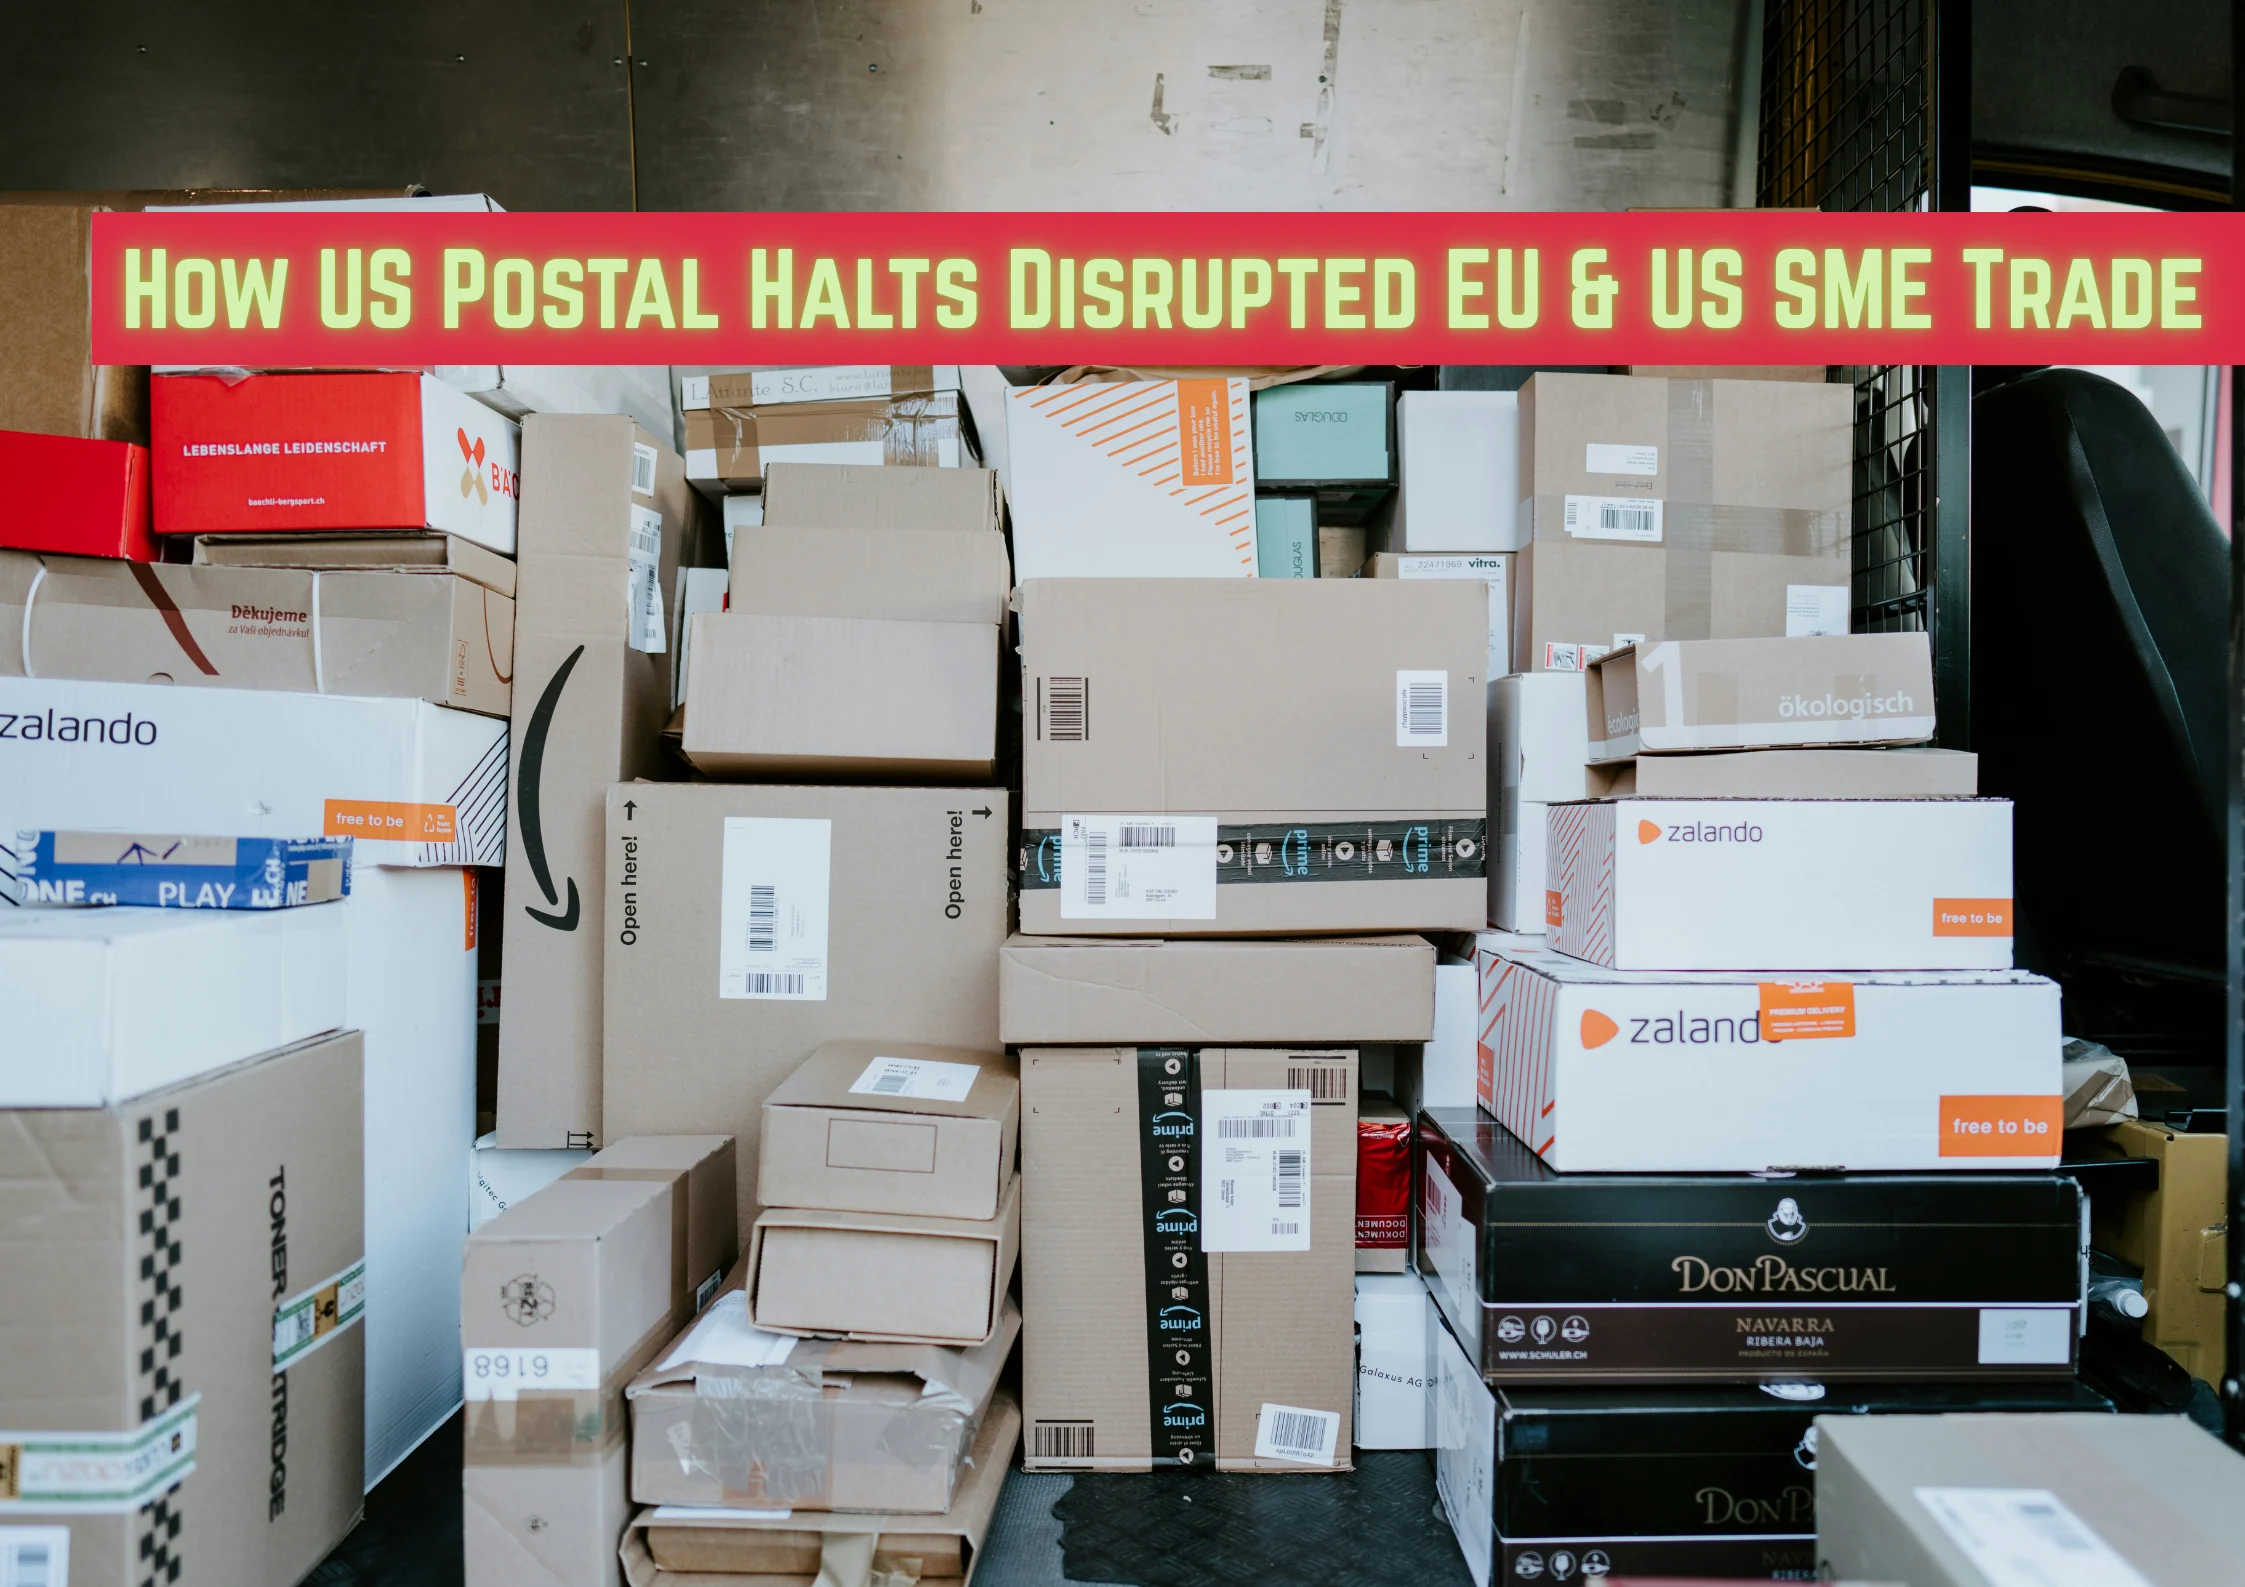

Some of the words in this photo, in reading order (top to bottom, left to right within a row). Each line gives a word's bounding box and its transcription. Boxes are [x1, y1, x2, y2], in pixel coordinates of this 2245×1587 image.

[782, 375, 818, 395] S.C.
[1206, 417, 1210, 426] me
[1295, 411, 1347, 422] DOUGLAS
[1213, 432, 1218, 440] be
[183, 443, 280, 457] LEBENSLANGE
[284, 440, 387, 454] LEIDENSCHAFT
[248, 496, 325, 507] baechli-bergsport.ch
[231, 604, 307, 623] Děkujeme
[228, 626, 238, 634] za
[239, 625, 256, 636] Vaši
[258, 627, 309, 638] objednávku!
[1778, 690, 1913, 721] ökologisch
[0, 707, 158, 747] zalando
[336, 812, 364, 827] free
[369, 813, 383, 827] to
[386, 813, 404, 828] be
[946, 810, 963, 860] here!
[1668, 821, 1763, 843] zalando
[1294, 829, 1311, 875] prime
[1415, 826, 1431, 872] prime
[621, 836, 638, 887] here!
[158, 881, 236, 909] PLAY
[944, 866, 965, 919] Open
[620, 892, 640, 946] Open
[1941, 911, 1967, 924] free
[1970, 912, 1984, 924] to
[1987, 911, 2003, 924] be
[1630, 1009, 1783, 1045] zaland
[1153, 1122, 1194, 1138] prime
[1952, 1117, 1993, 1135] free
[1998, 1118, 2018, 1135] to
[2023, 1117, 2048, 1135] be
[268, 1165, 288, 1296] TONER
[1156, 1219, 1198, 1235] prime
[1160, 1316, 1201, 1332] prime
[1735, 1317, 1835, 1333] NAVARRA
[1746, 1336, 1791, 1346] RIBERA
[1795, 1336, 1824, 1346] BAJA
[1498, 1350, 1588, 1360] WWW.SCHULER.CH
[474, 1355, 548, 1378] 6168
[1359, 1364, 1403, 1384] Galaxus
[1407, 1375, 1423, 1388] AG
[1163, 1413, 1205, 1429] prime
